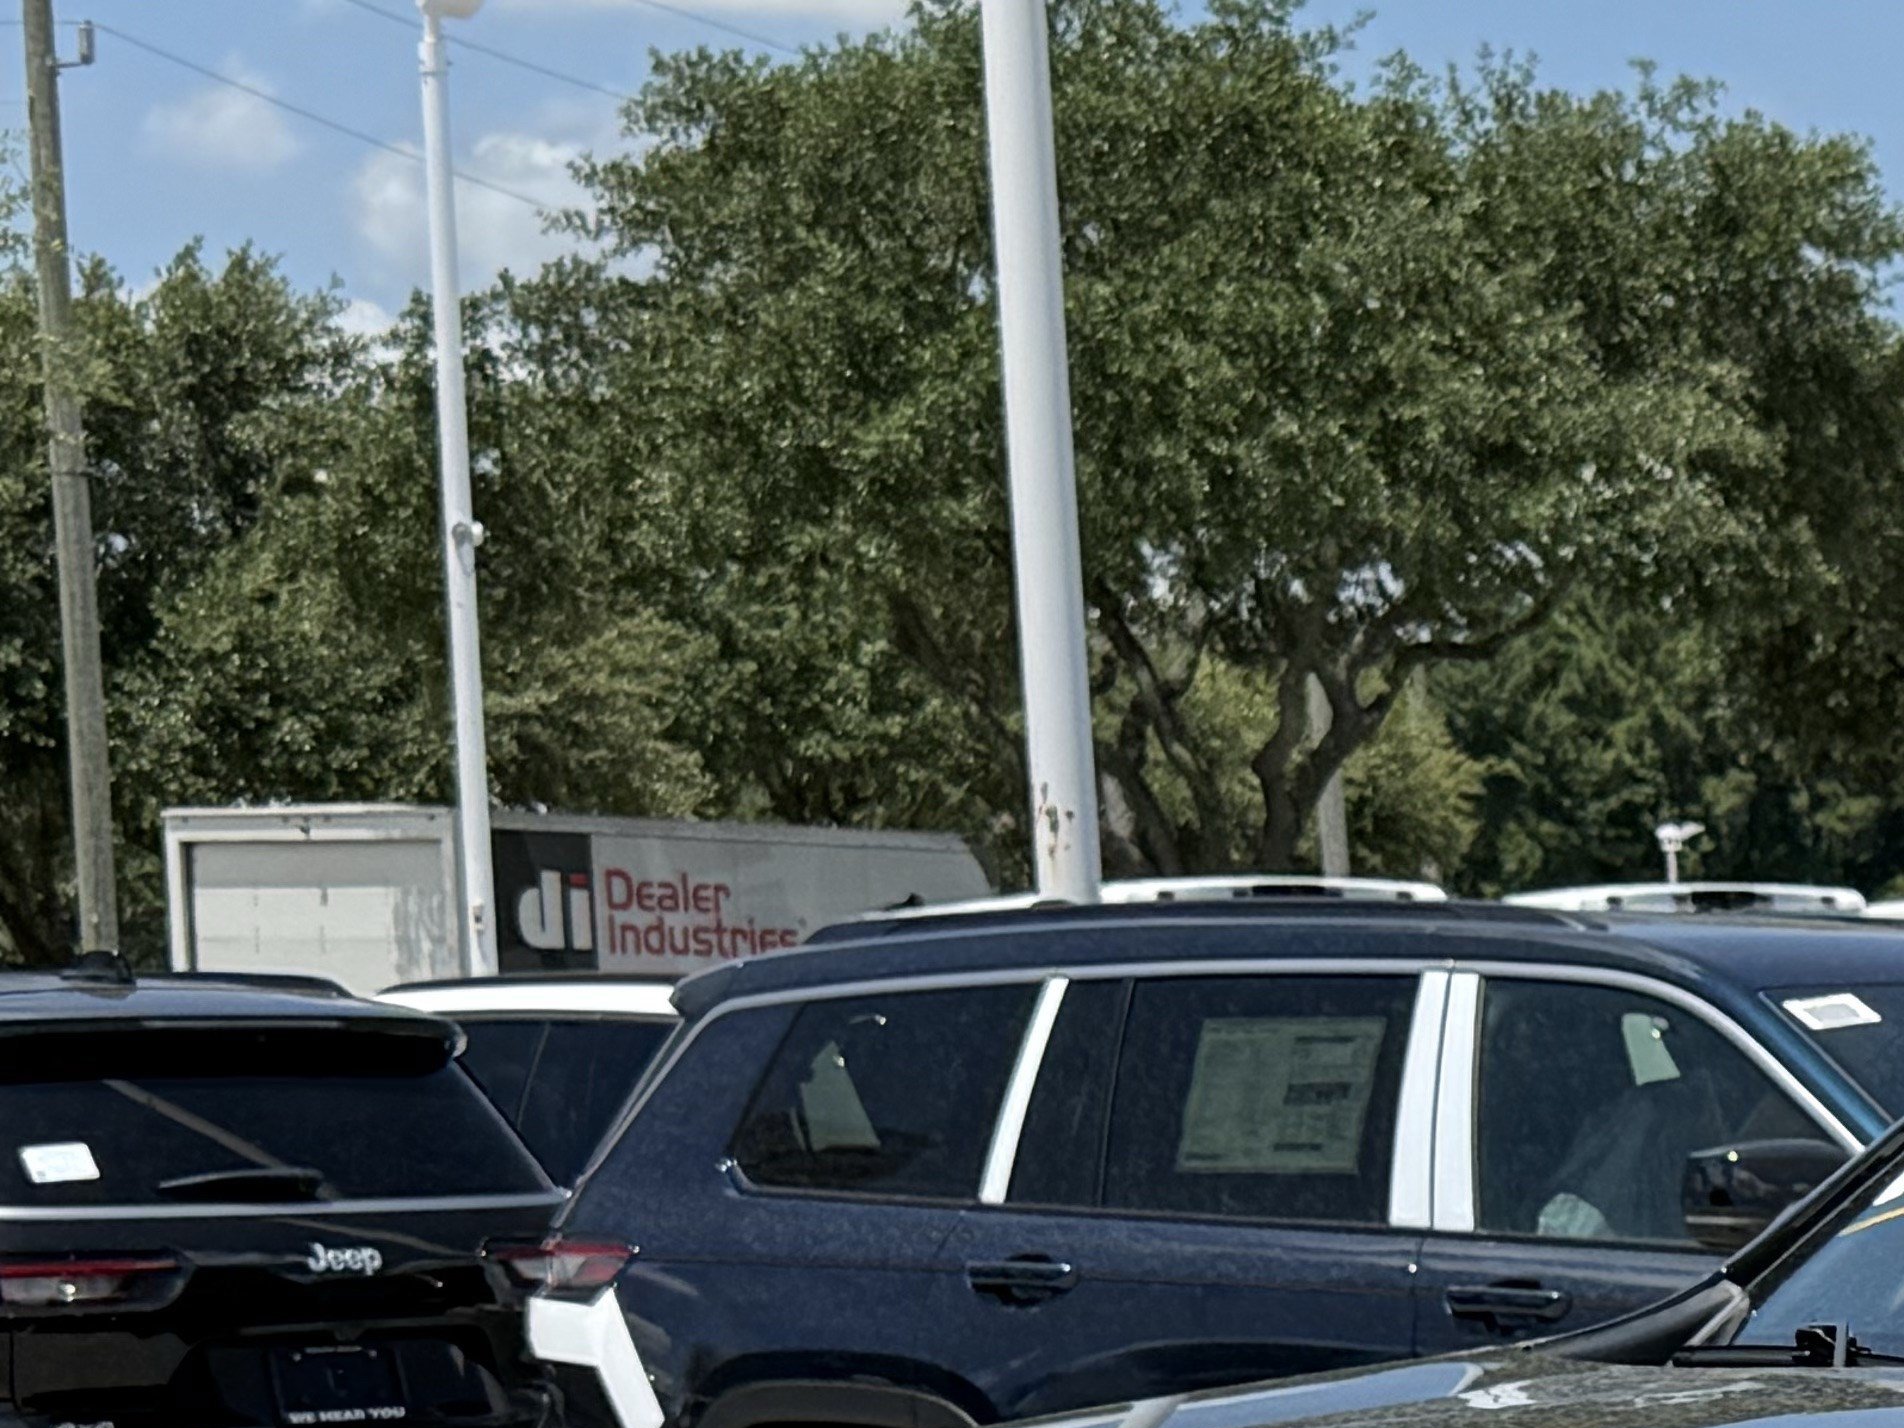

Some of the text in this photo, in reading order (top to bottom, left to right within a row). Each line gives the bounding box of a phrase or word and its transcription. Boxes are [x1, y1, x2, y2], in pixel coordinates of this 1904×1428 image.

[517, 869, 593, 950] di
[604, 867, 731, 914] Dealer
[608, 914, 799, 958] Industries
[307, 1242, 383, 1276] Jeep
[287, 1406, 406, 1424] WE HEAR YOU
